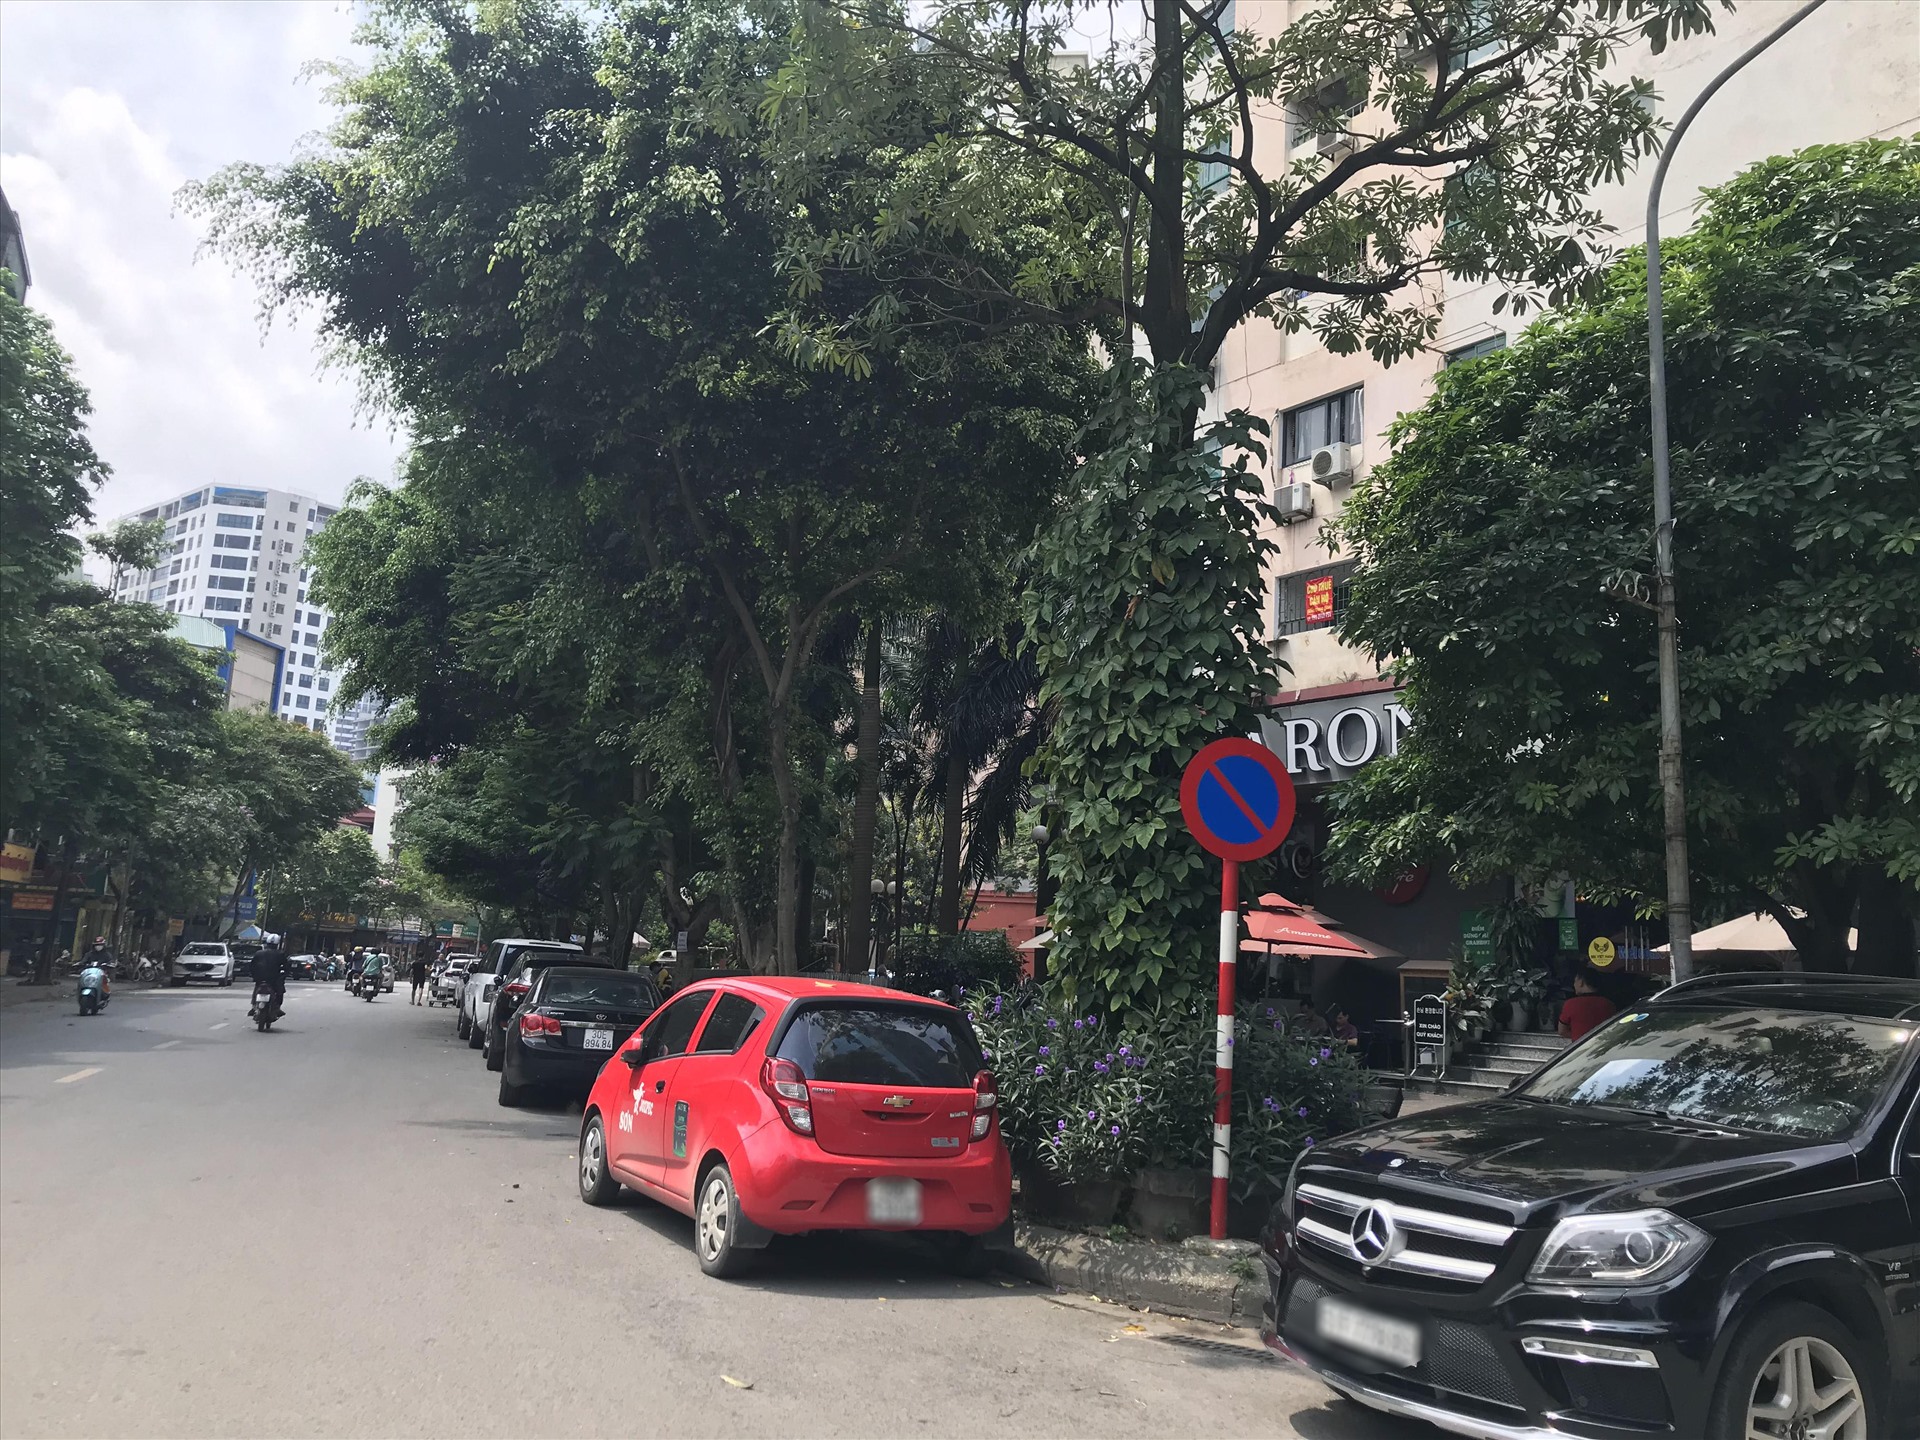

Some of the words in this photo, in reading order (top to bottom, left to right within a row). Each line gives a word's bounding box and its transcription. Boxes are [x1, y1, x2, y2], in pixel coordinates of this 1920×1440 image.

[1274, 927, 1332, 939] Amarone
[592, 1030, 607, 1040] 30E
[585, 1039, 612, 1049] 894.84
[1887, 1262, 1901, 1271] V8
